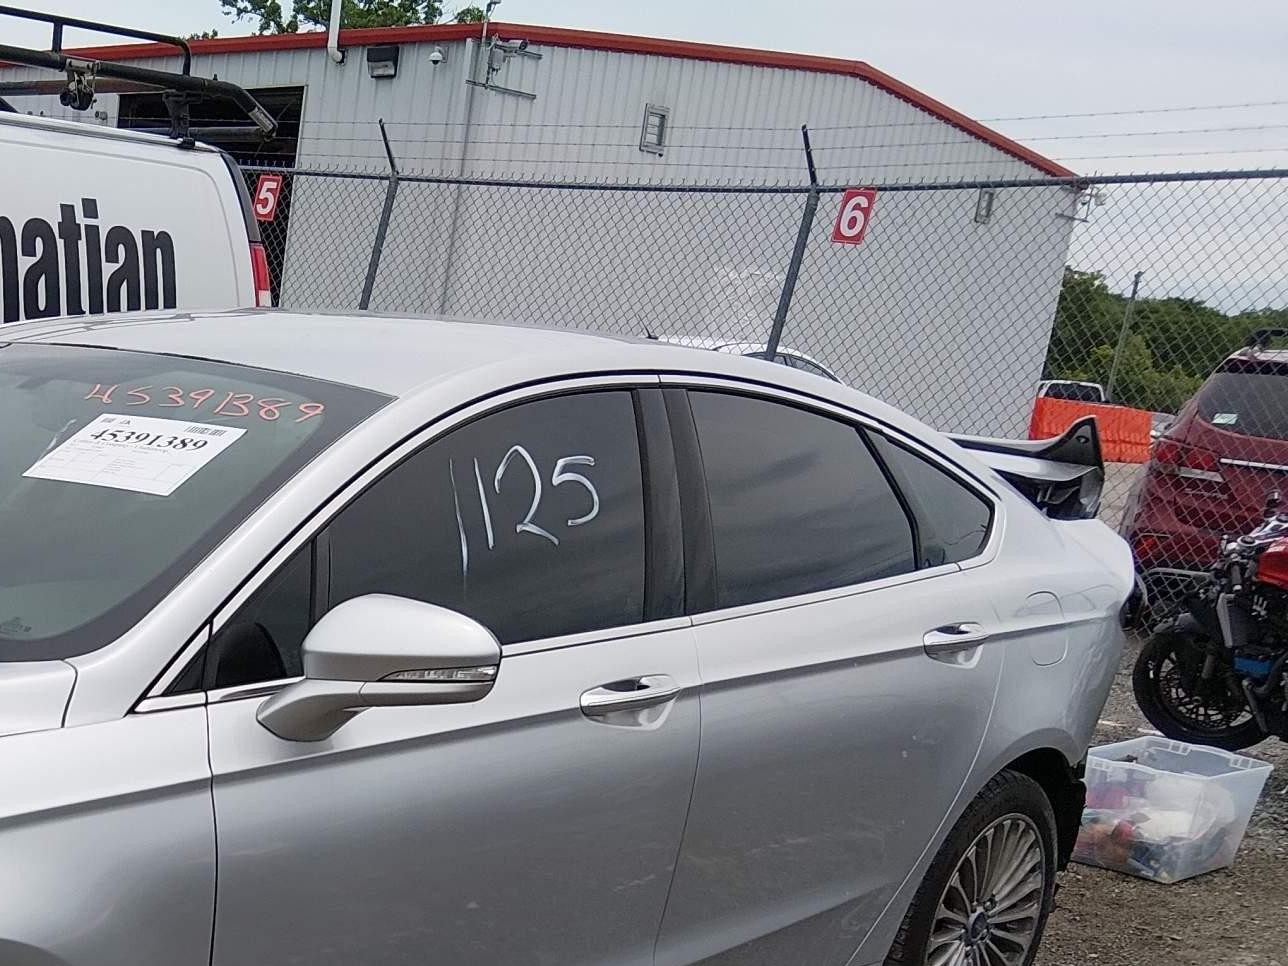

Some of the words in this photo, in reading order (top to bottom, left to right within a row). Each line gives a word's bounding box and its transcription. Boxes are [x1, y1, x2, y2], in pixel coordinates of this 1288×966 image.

[255, 180, 278, 215] 5
[839, 195, 870, 238] 6
[90, 427, 209, 452] 45391389
[448, 444, 600, 577] 1125
